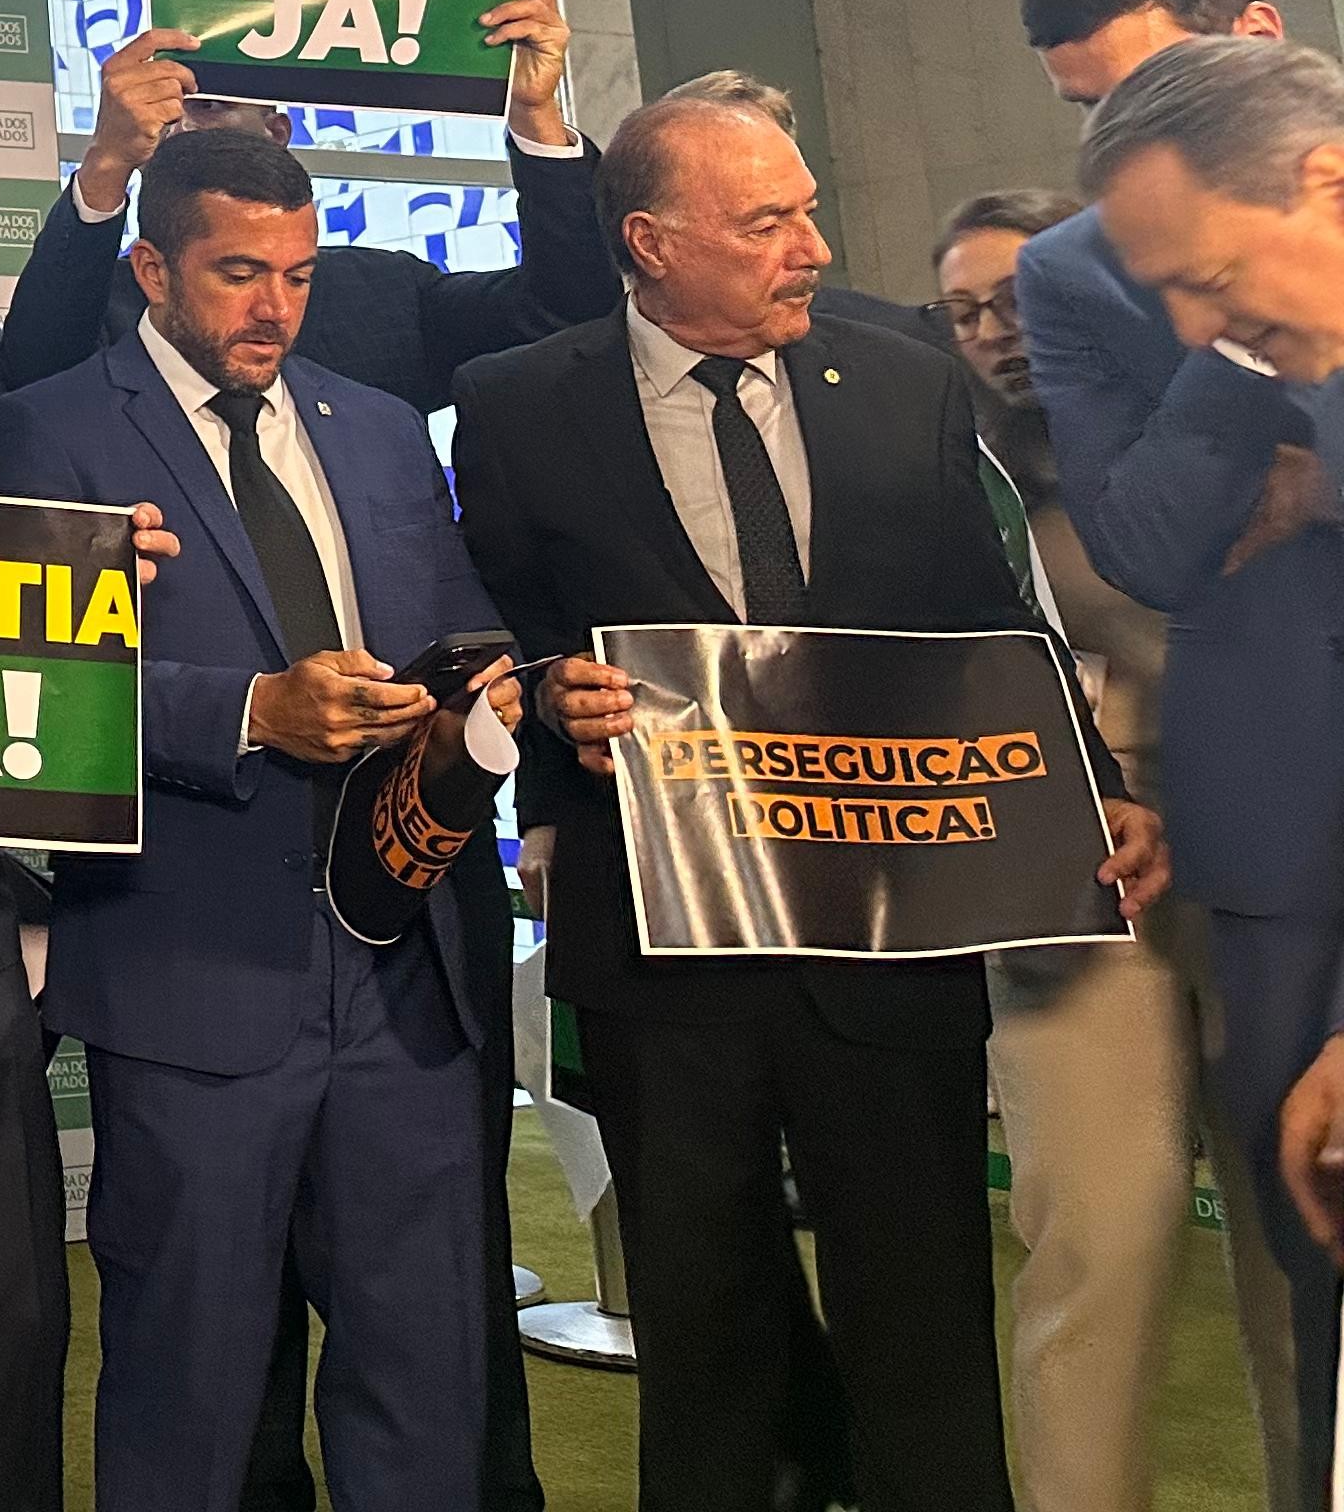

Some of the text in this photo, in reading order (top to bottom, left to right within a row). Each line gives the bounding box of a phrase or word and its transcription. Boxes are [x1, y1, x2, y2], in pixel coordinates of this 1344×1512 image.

[4, 117, 28, 130] DOS
[12, 215, 35, 228] DOS
[662, 735, 1042, 786] PERSEGUIÇÃO
[732, 797, 994, 842] POLÍTICA!
